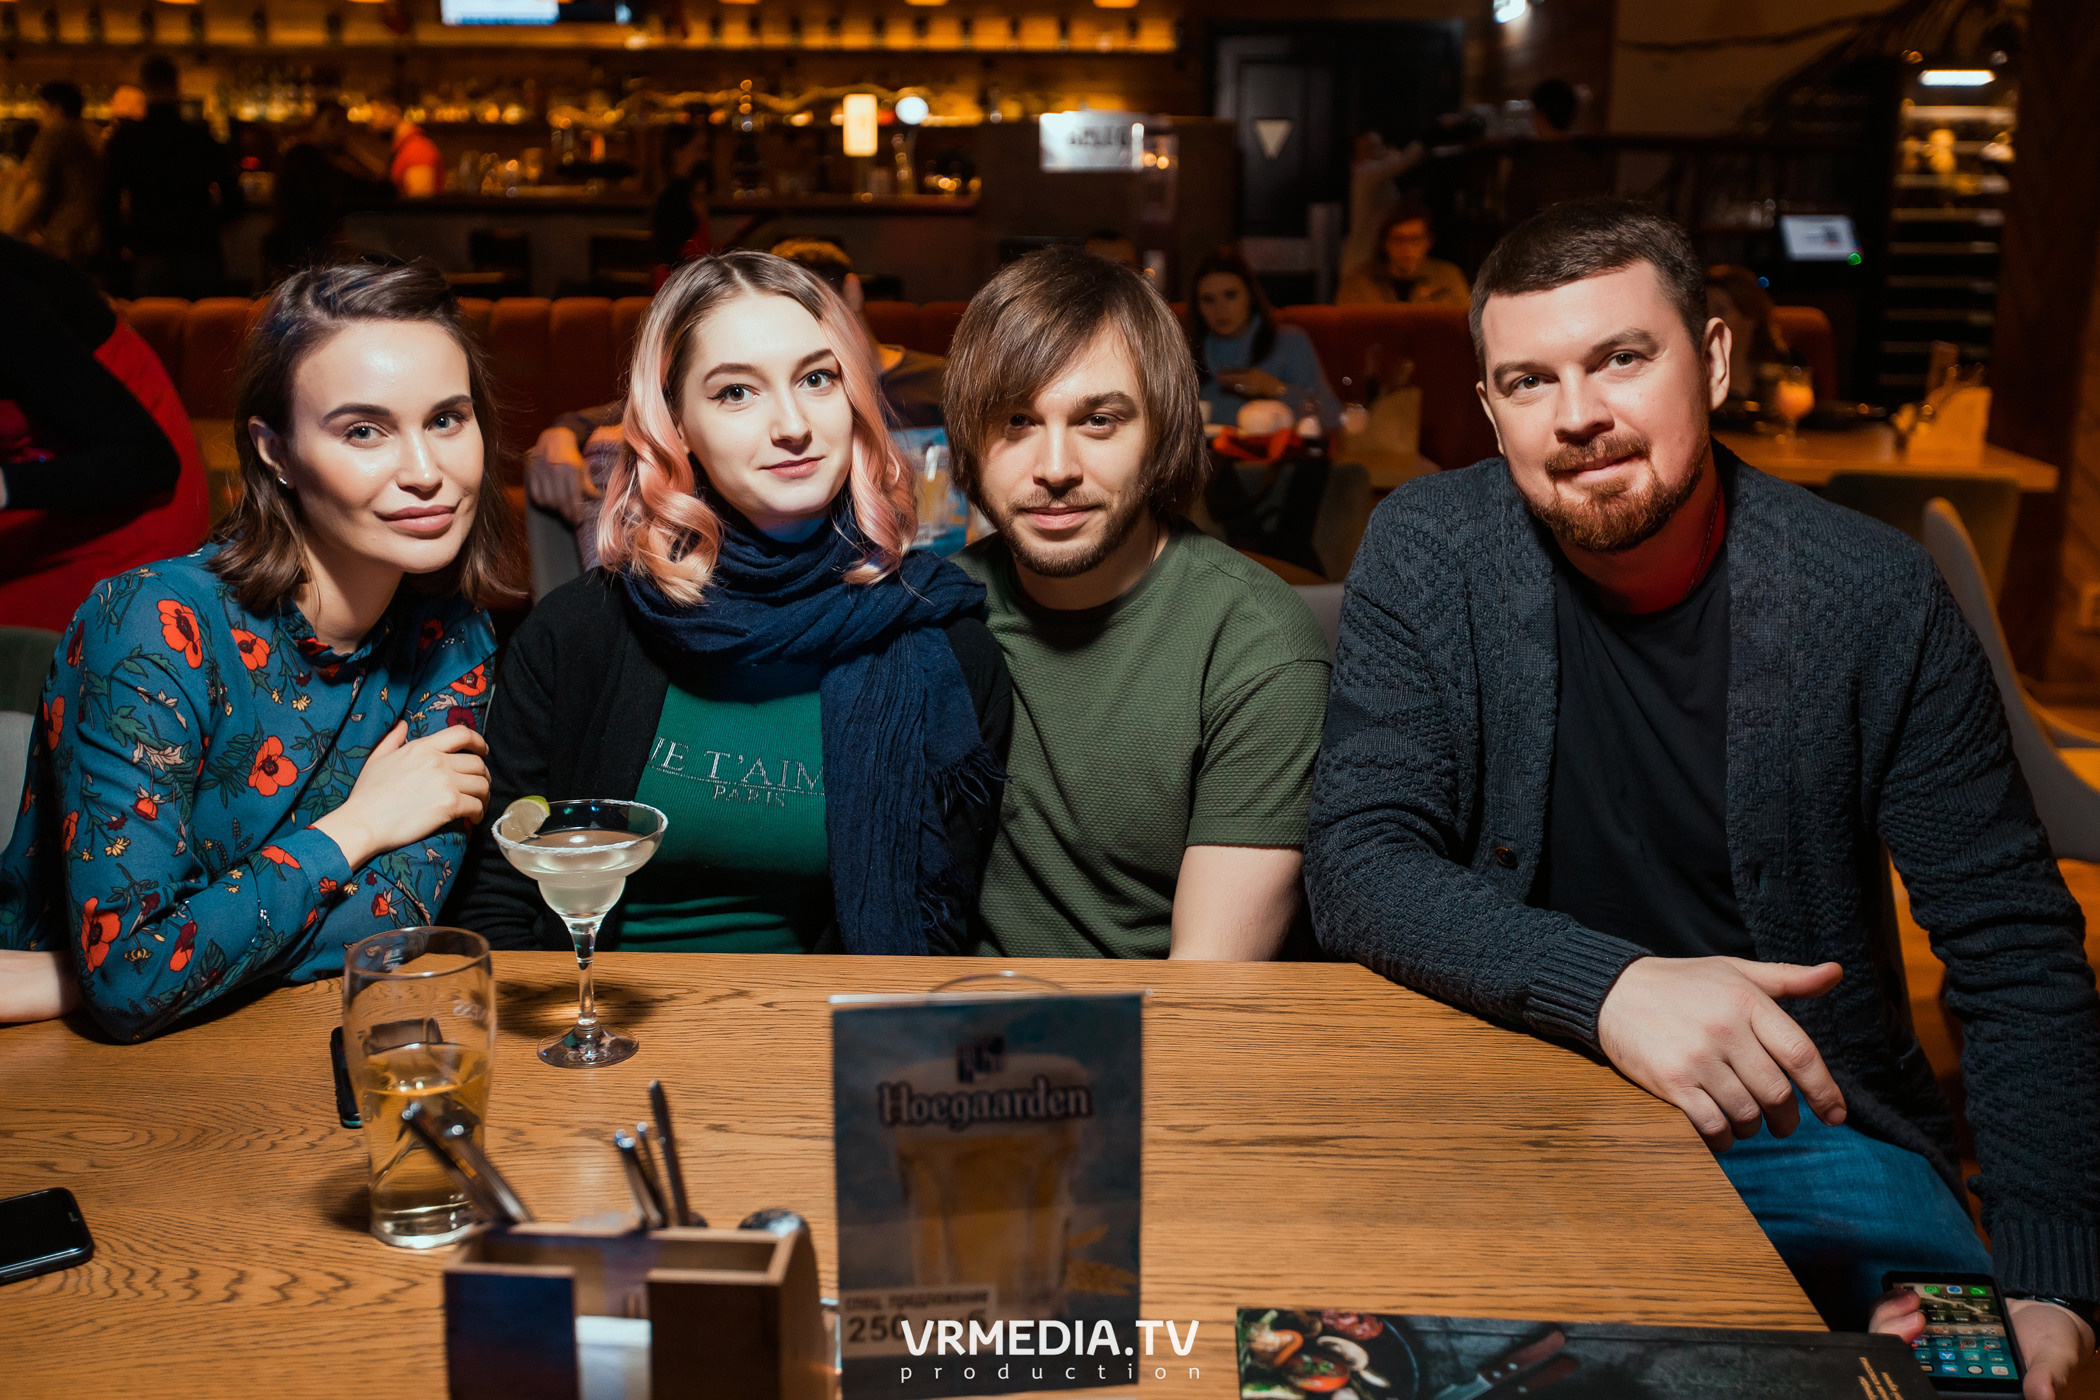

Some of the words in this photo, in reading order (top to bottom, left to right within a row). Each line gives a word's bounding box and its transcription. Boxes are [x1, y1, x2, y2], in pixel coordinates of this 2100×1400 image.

[712, 784, 785, 807] PARIS
[880, 1075, 1092, 1131] Hoegaarden
[848, 1313, 907, 1343] 250
